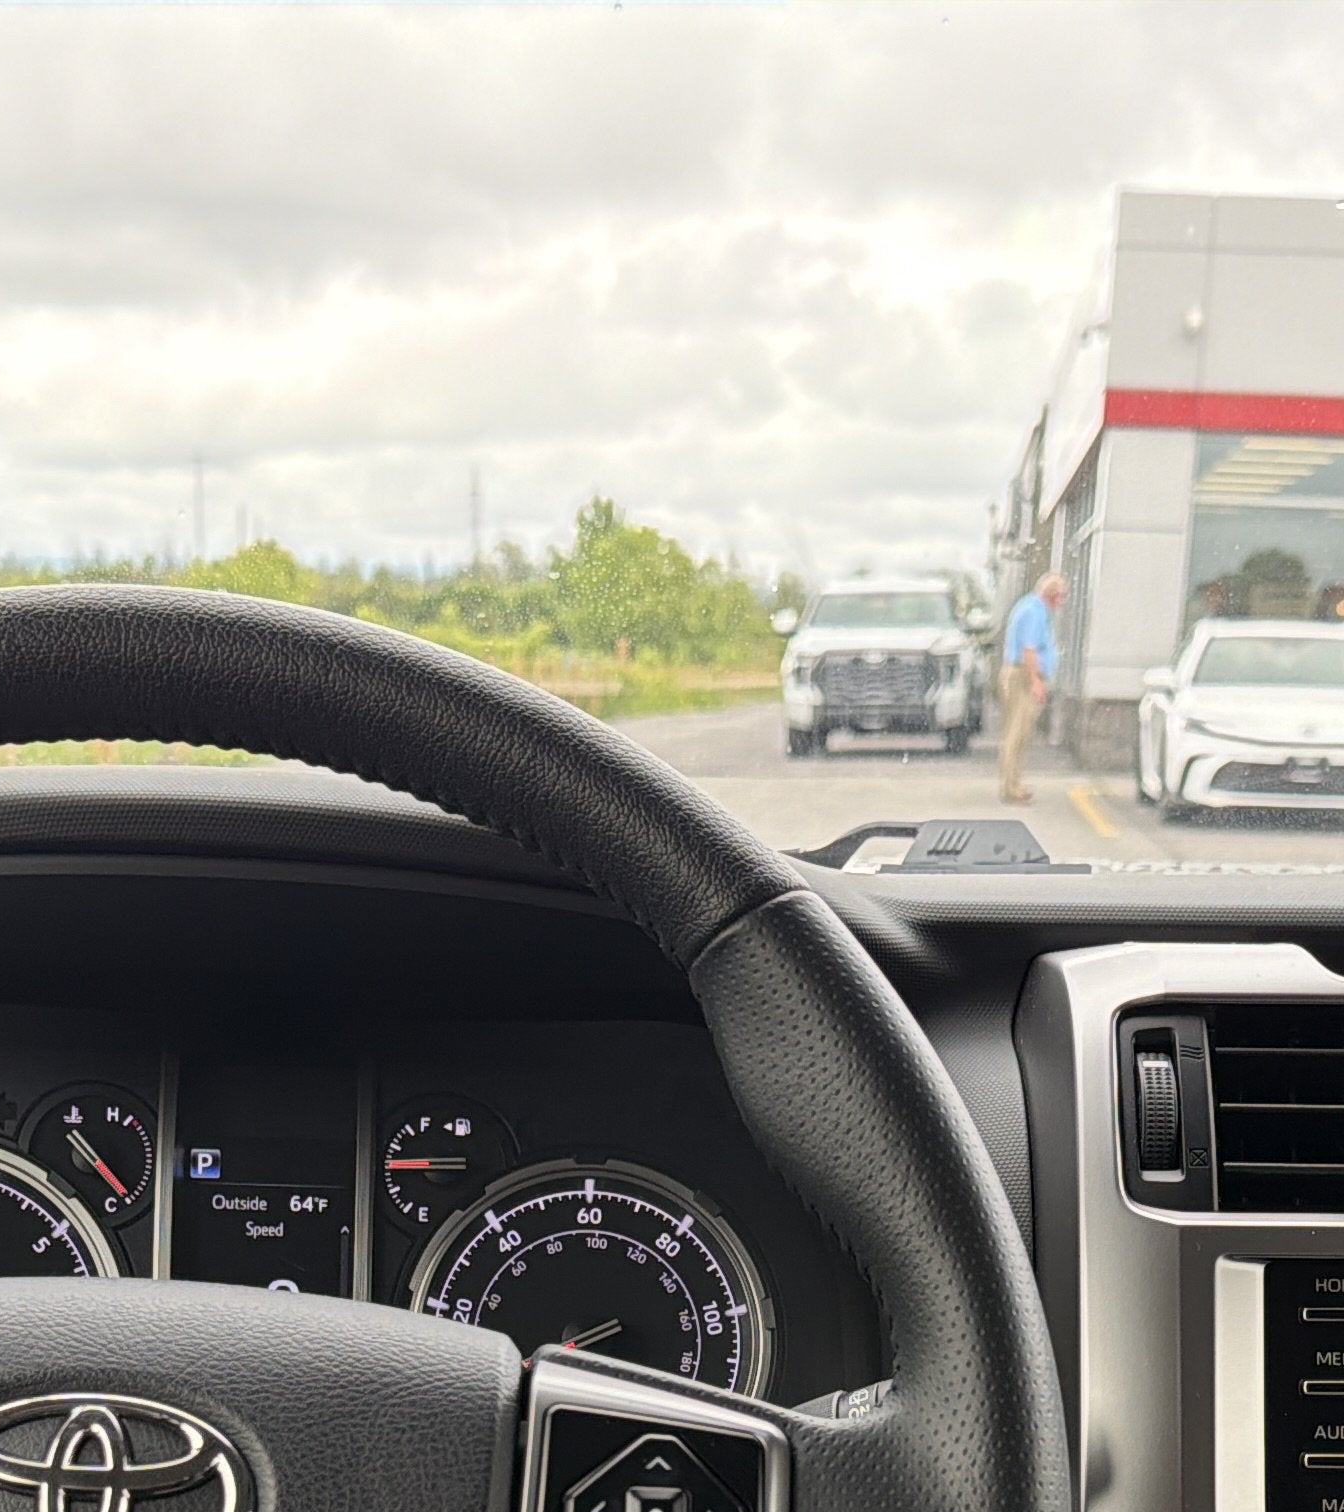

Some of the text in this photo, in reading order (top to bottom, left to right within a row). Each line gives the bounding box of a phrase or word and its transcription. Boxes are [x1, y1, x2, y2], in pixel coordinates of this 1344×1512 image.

[107, 1107, 119, 1122] H
[419, 1117, 431, 1132] F
[197, 1153, 214, 1174] P
[104, 1197, 118, 1214] C
[212, 1195, 268, 1212] Outside
[418, 1207, 429, 1223] E
[576, 1207, 602, 1225] 60
[245, 1221, 285, 1240] Speed
[31, 1236, 52, 1255] 5
[497, 1230, 523, 1255] 40
[546, 1240, 563, 1255] 80
[586, 1236, 609, 1250] 100
[654, 1232, 682, 1258] 80
[625, 1245, 648, 1266] 120
[510, 1260, 528, 1278] 60
[658, 1272, 678, 1295] 140
[487, 1293, 503, 1312] 40
[677, 1308, 693, 1333] 160
[702, 1300, 724, 1337] 100
[679, 1350, 693, 1373] 180
